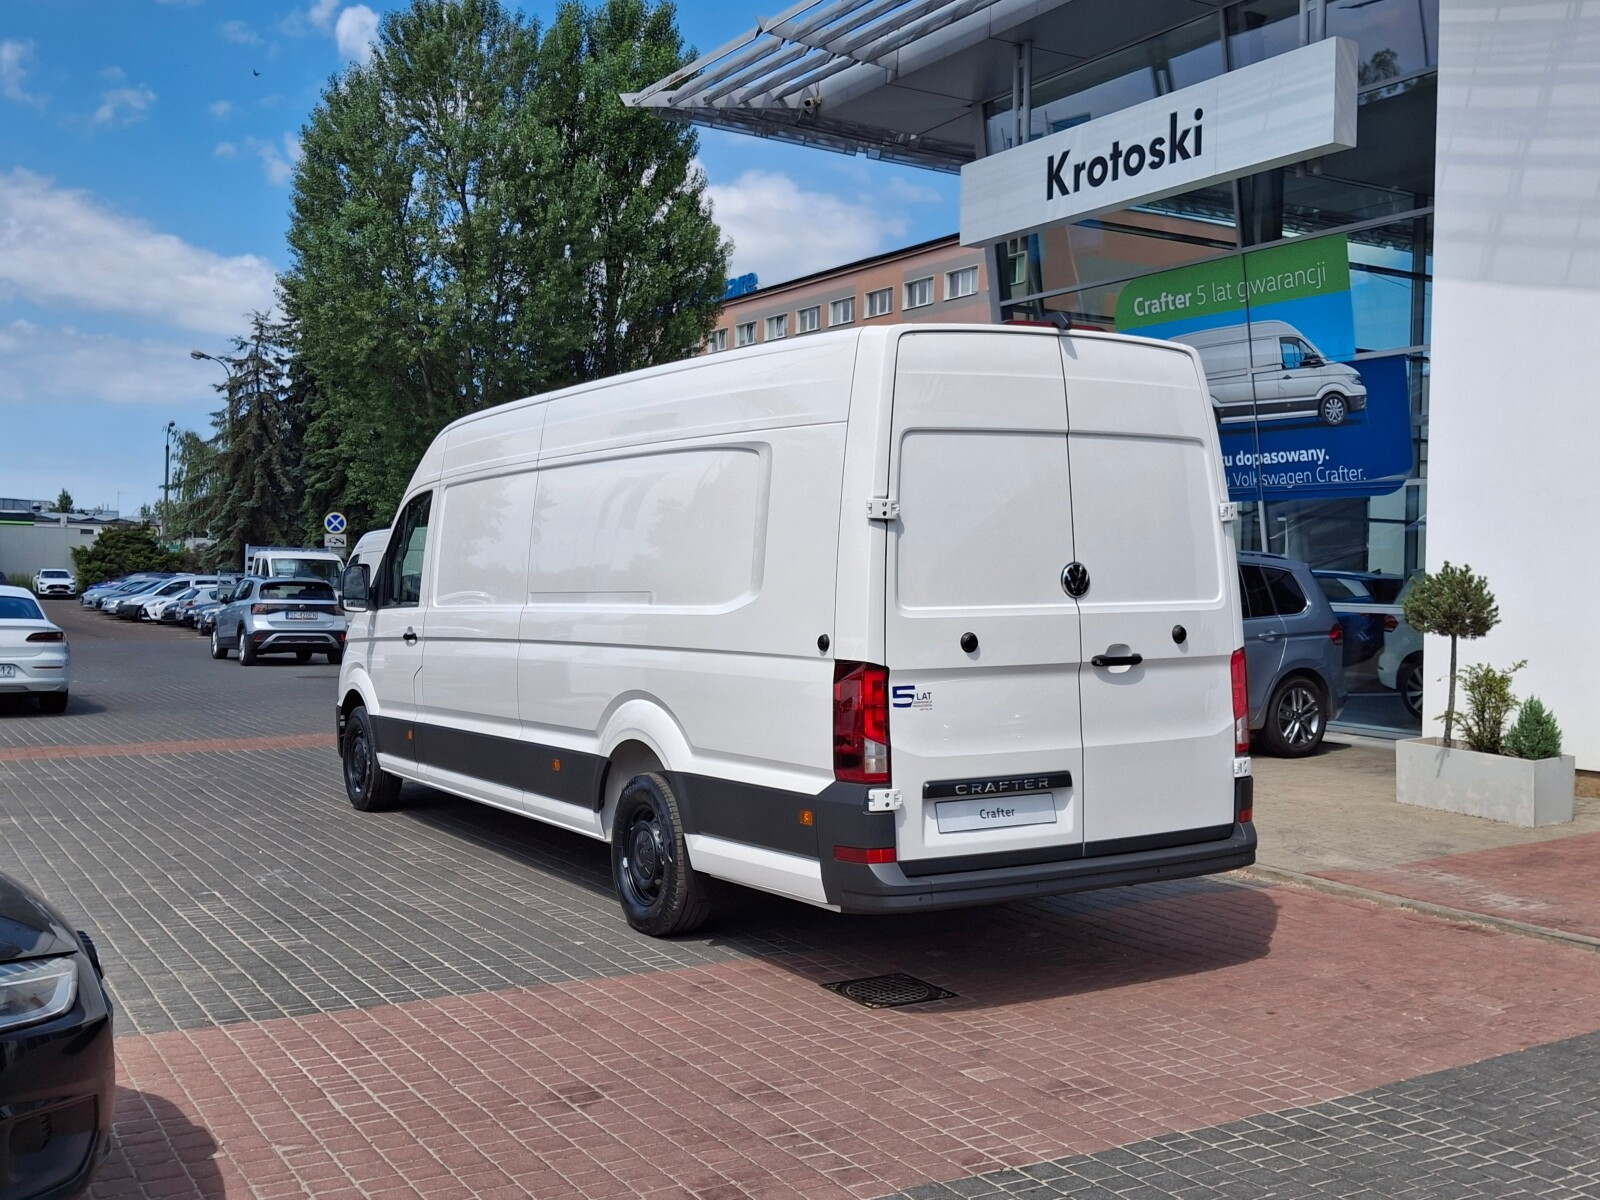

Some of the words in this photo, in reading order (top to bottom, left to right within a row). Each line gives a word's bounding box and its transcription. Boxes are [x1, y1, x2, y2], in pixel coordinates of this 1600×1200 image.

[1047, 108, 1203, 200] Krotoski
[1133, 292, 1192, 316] Crafter
[1197, 285, 1206, 305] 5
[1212, 282, 1232, 302] lat
[1237, 261, 1326, 303] gwarancji
[1236, 448, 1329, 469] dopasowany.
[1233, 470, 1312, 488] Volkswagen
[1316, 465, 1366, 483] Crafter.
[892, 685, 915, 708] 5
[916, 692, 932, 701] LAT
[955, 778, 1049, 795] CRAFTER
[979, 808, 1015, 819] Crafter
